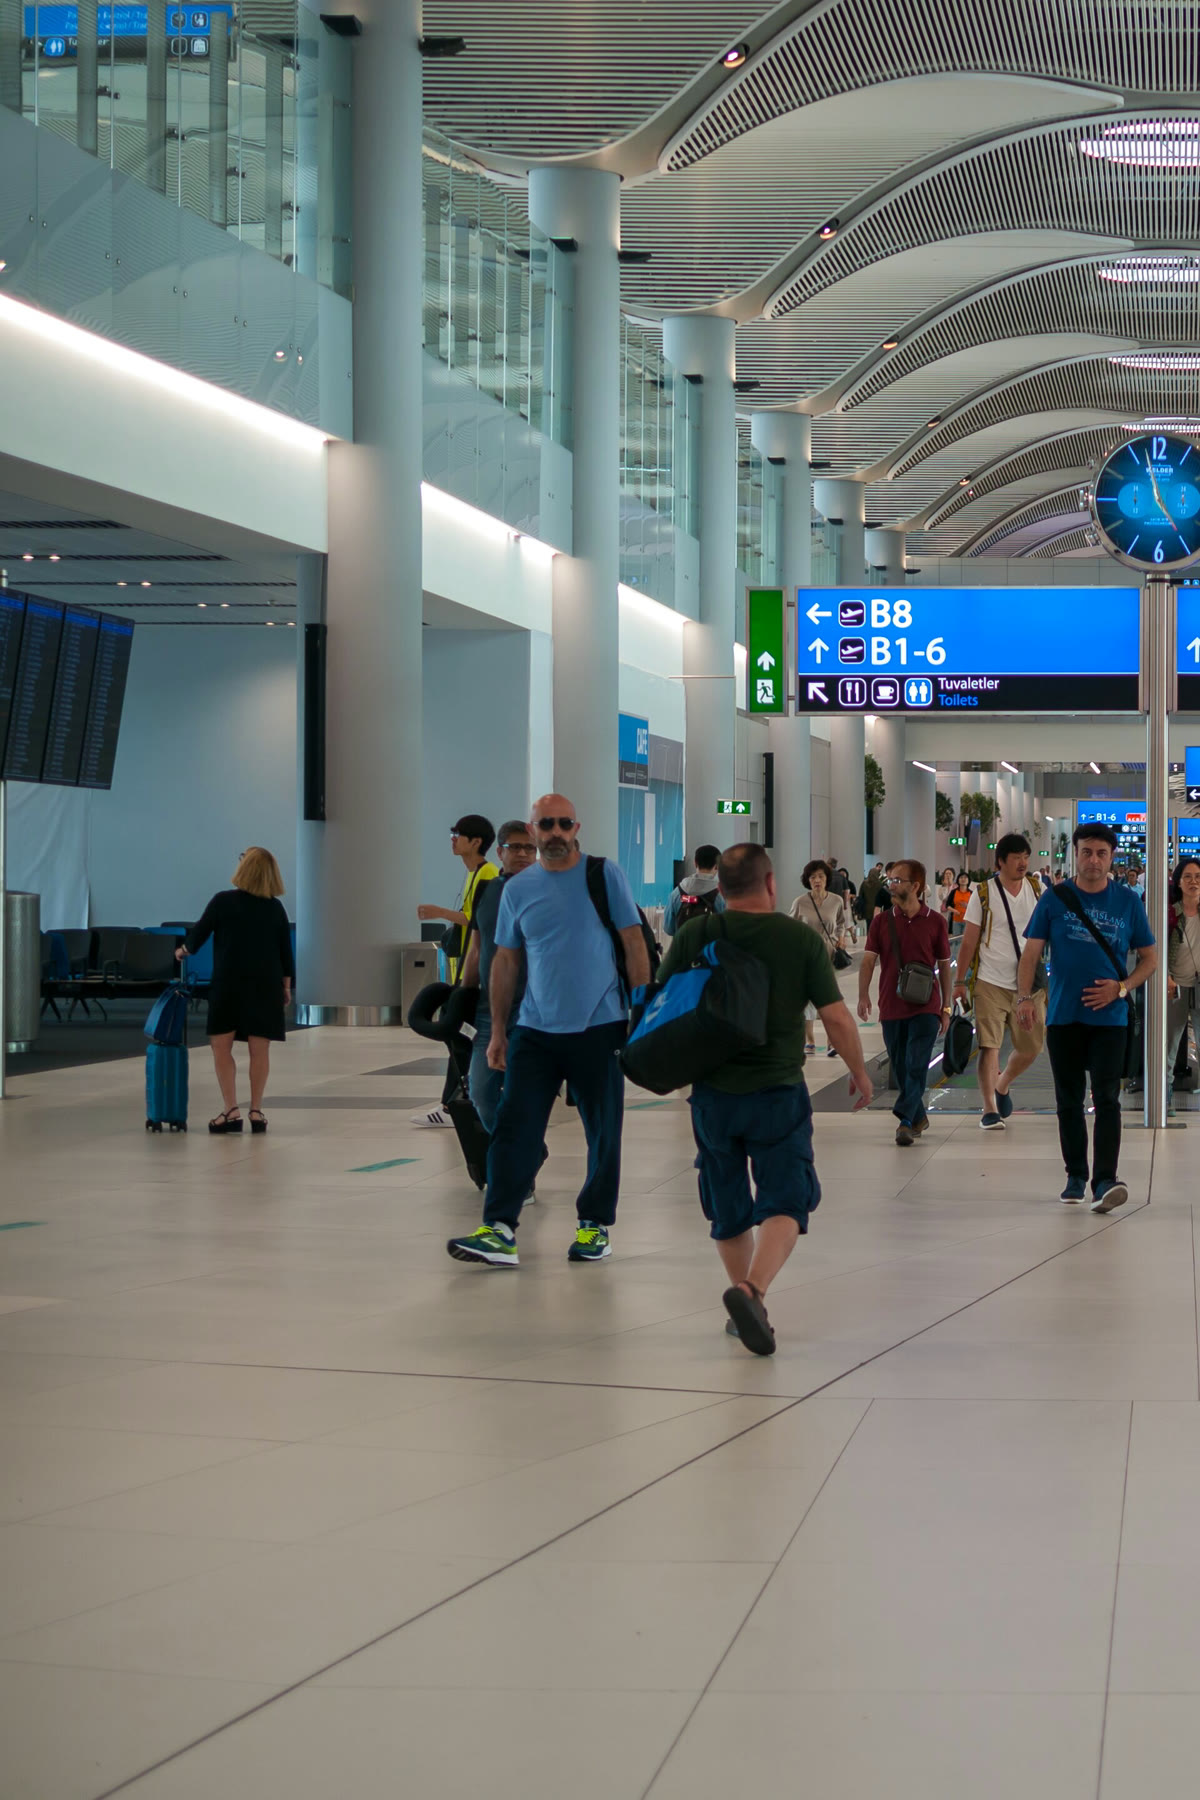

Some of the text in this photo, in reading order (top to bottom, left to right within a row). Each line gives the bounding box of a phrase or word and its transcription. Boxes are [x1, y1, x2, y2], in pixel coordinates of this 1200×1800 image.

[1152, 437, 1167, 460] 12
[1154, 540, 1164, 563] 6
[871, 599, 913, 629] B8
[871, 637, 946, 665] B1-6
[938, 677, 1000, 690] Tuvaletler
[938, 694, 979, 706] Toilets
[1096, 812, 1117, 821] B1-6
